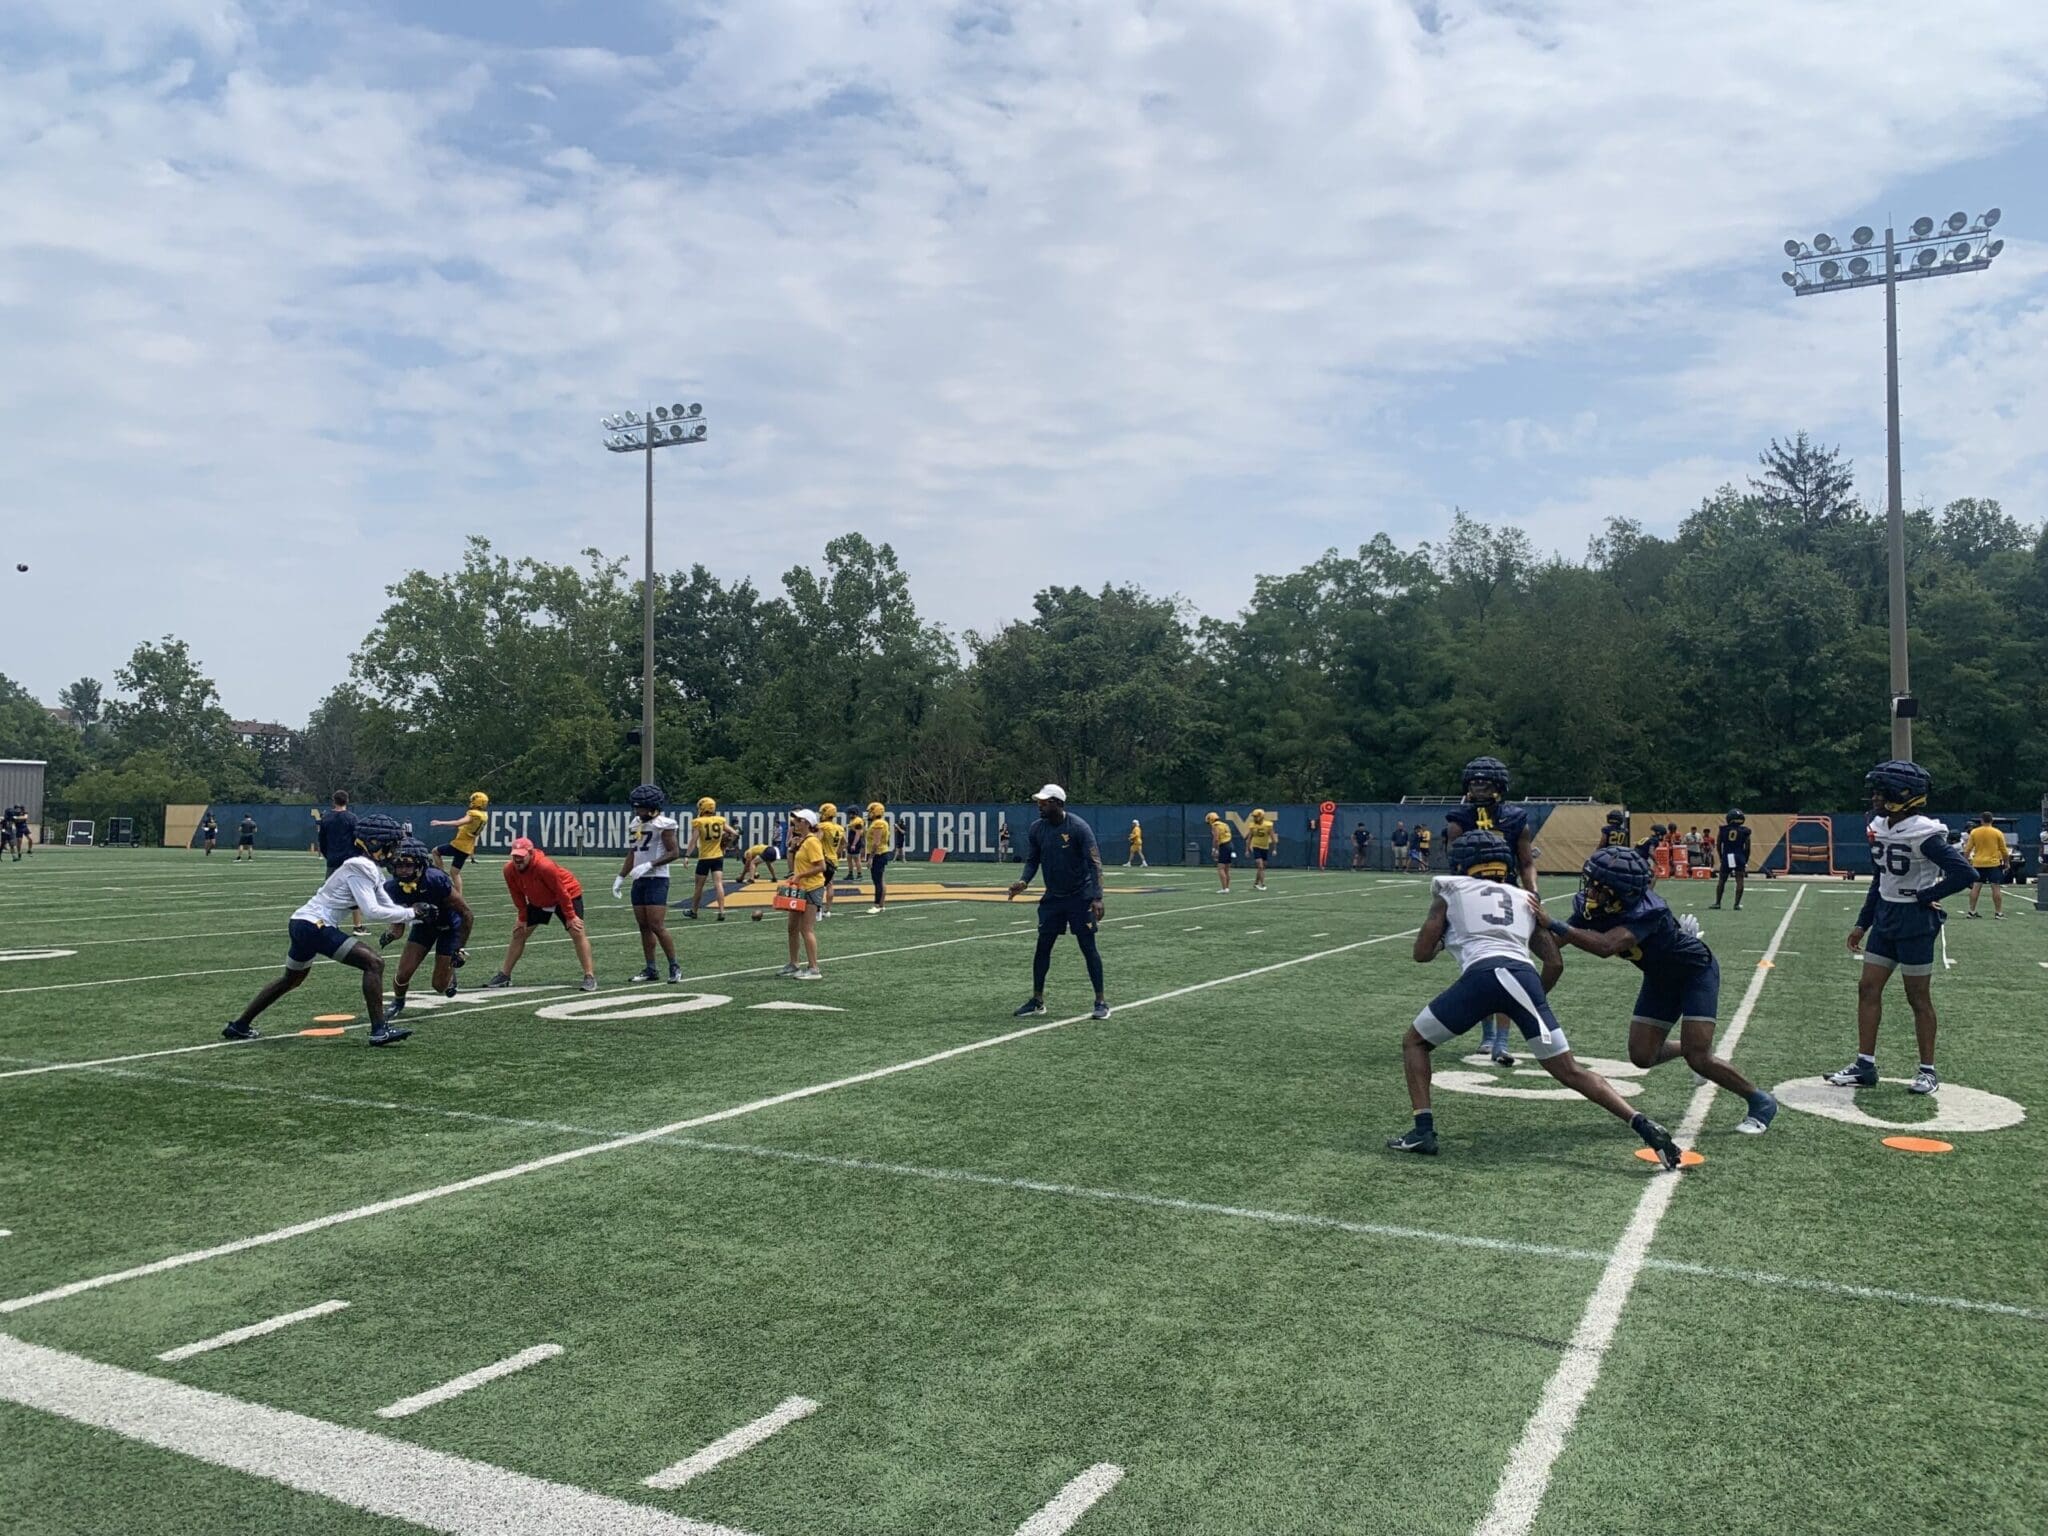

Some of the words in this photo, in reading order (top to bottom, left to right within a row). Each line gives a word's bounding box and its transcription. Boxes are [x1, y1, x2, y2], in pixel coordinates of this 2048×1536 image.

[540, 811, 632, 848] VIRGINI
[704, 822, 721, 841] 19
[1609, 831, 1625, 845] 20
[1729, 830, 1738, 841] 0
[1871, 841, 1913, 877] 26
[789, 900, 798, 909] G
[1480, 886, 1514, 926] 3
[1770, 1076, 2027, 1132] 0
